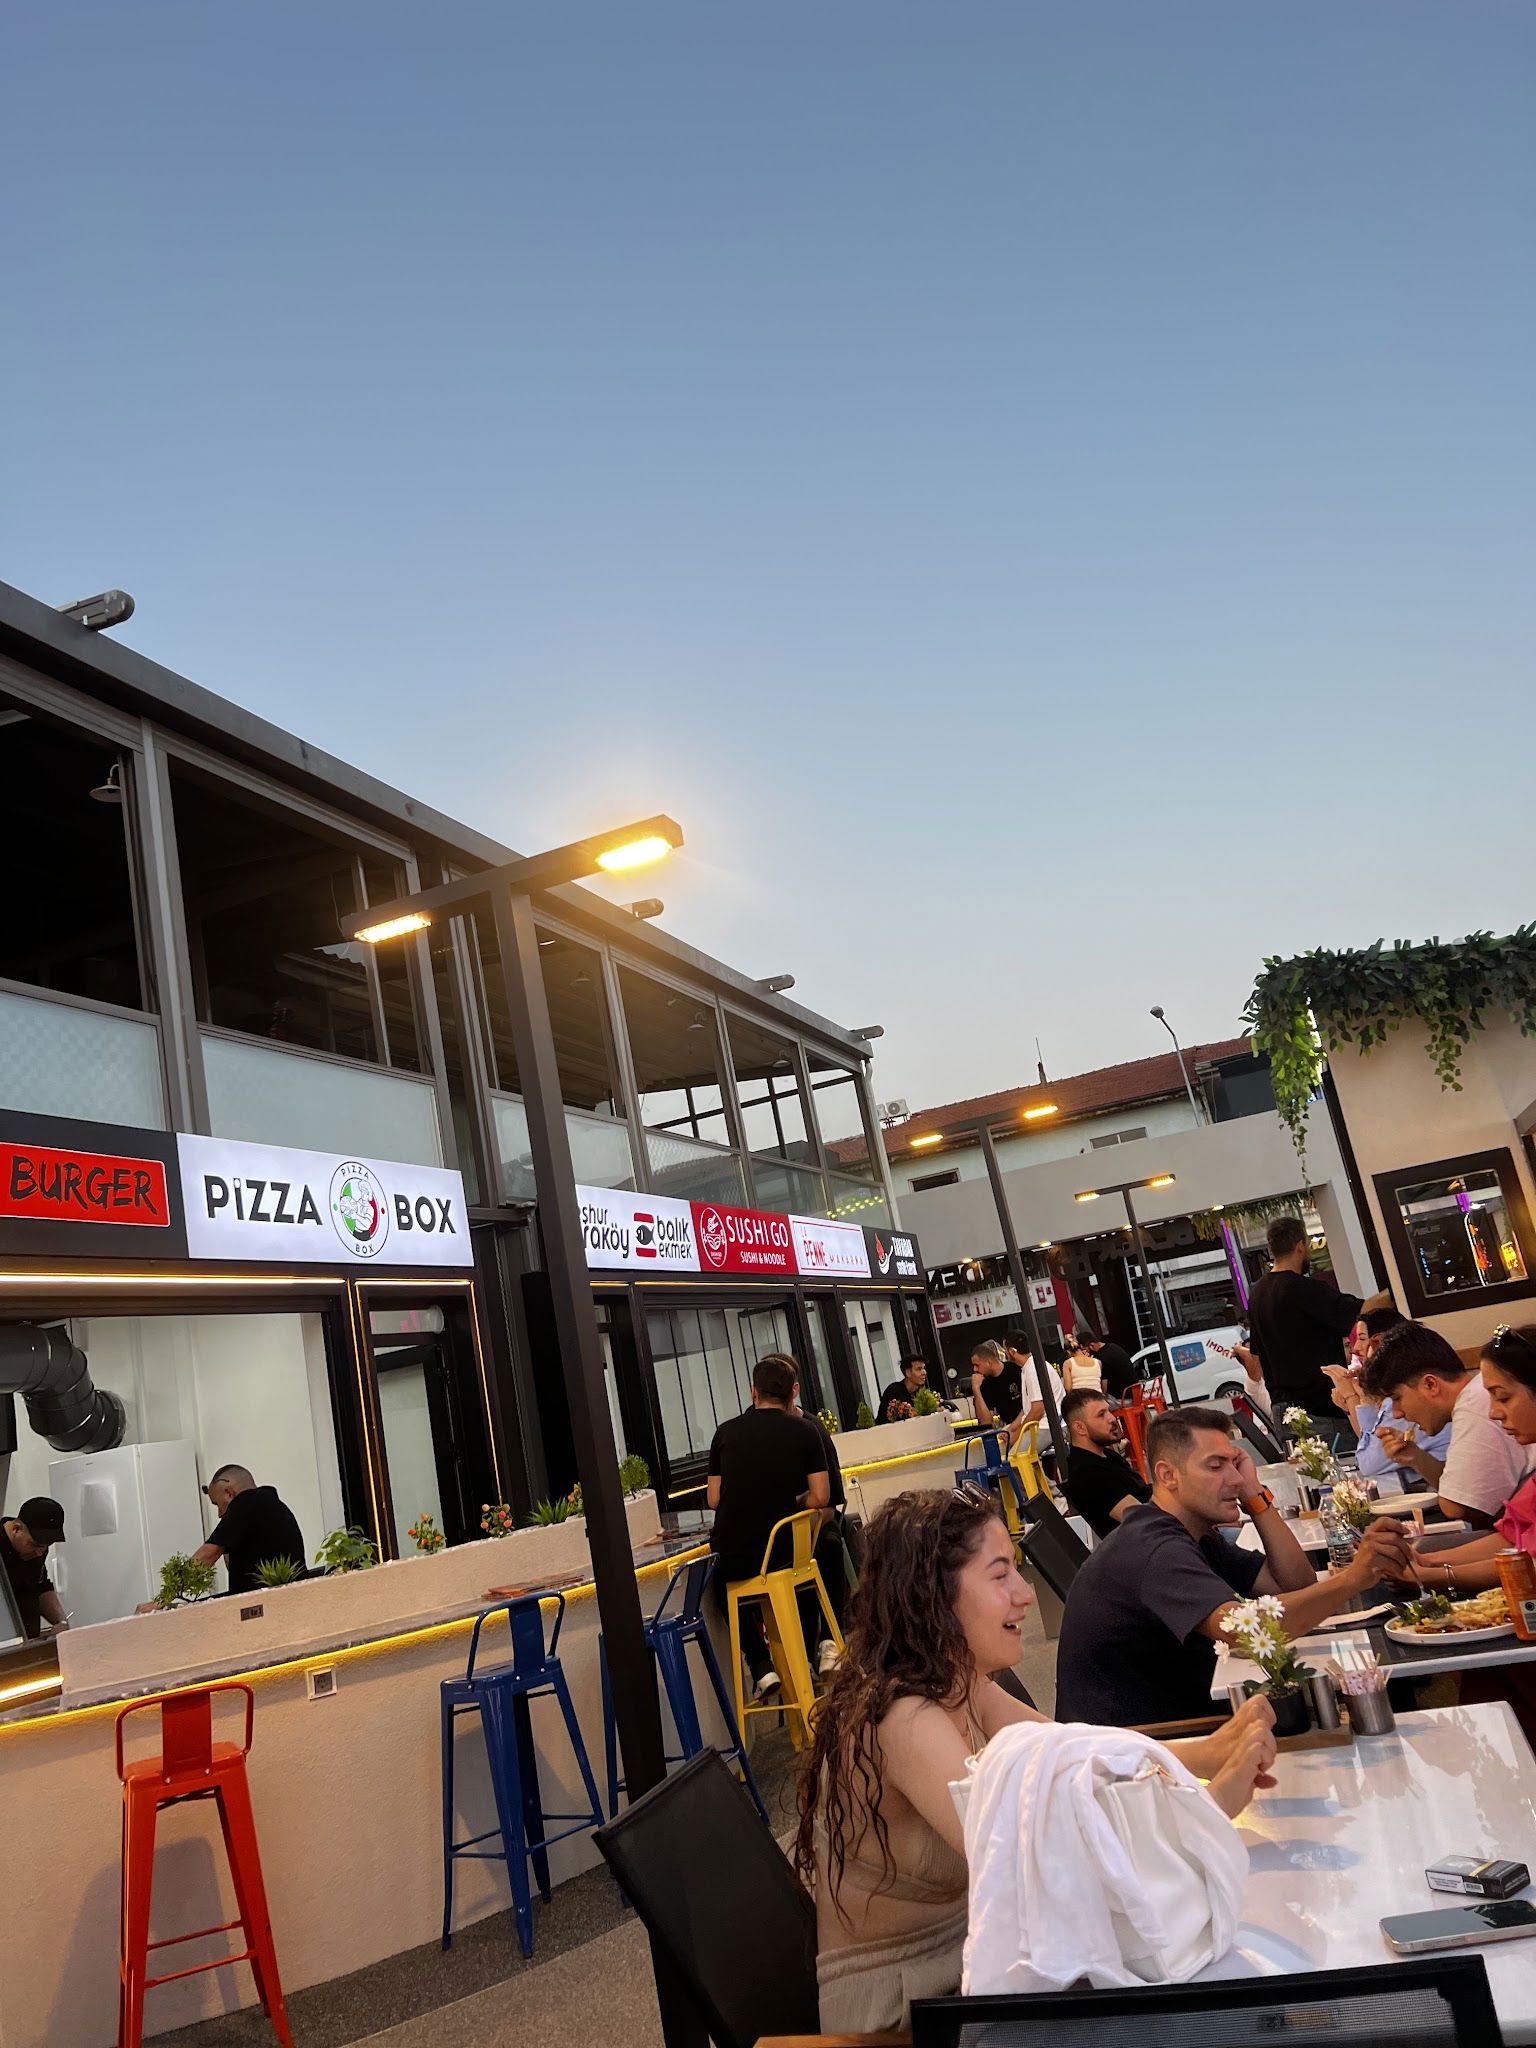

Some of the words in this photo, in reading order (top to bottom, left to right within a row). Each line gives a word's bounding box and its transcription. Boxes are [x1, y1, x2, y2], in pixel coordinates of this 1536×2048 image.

[340, 1164, 370, 1180] PIZZA
[10, 1155, 158, 1216] BURGER
[393, 1193, 457, 1235] BOX
[725, 1215, 770, 1246] SUSHI
[769, 1221, 789, 1248] GO
[354, 1243, 375, 1255] BOX
[658, 1241, 693, 1260] ekmek
[740, 1250, 758, 1264] SUSHI
[763, 1252, 787, 1266] NOODLE
[803, 1239, 828, 1267] PENNE
